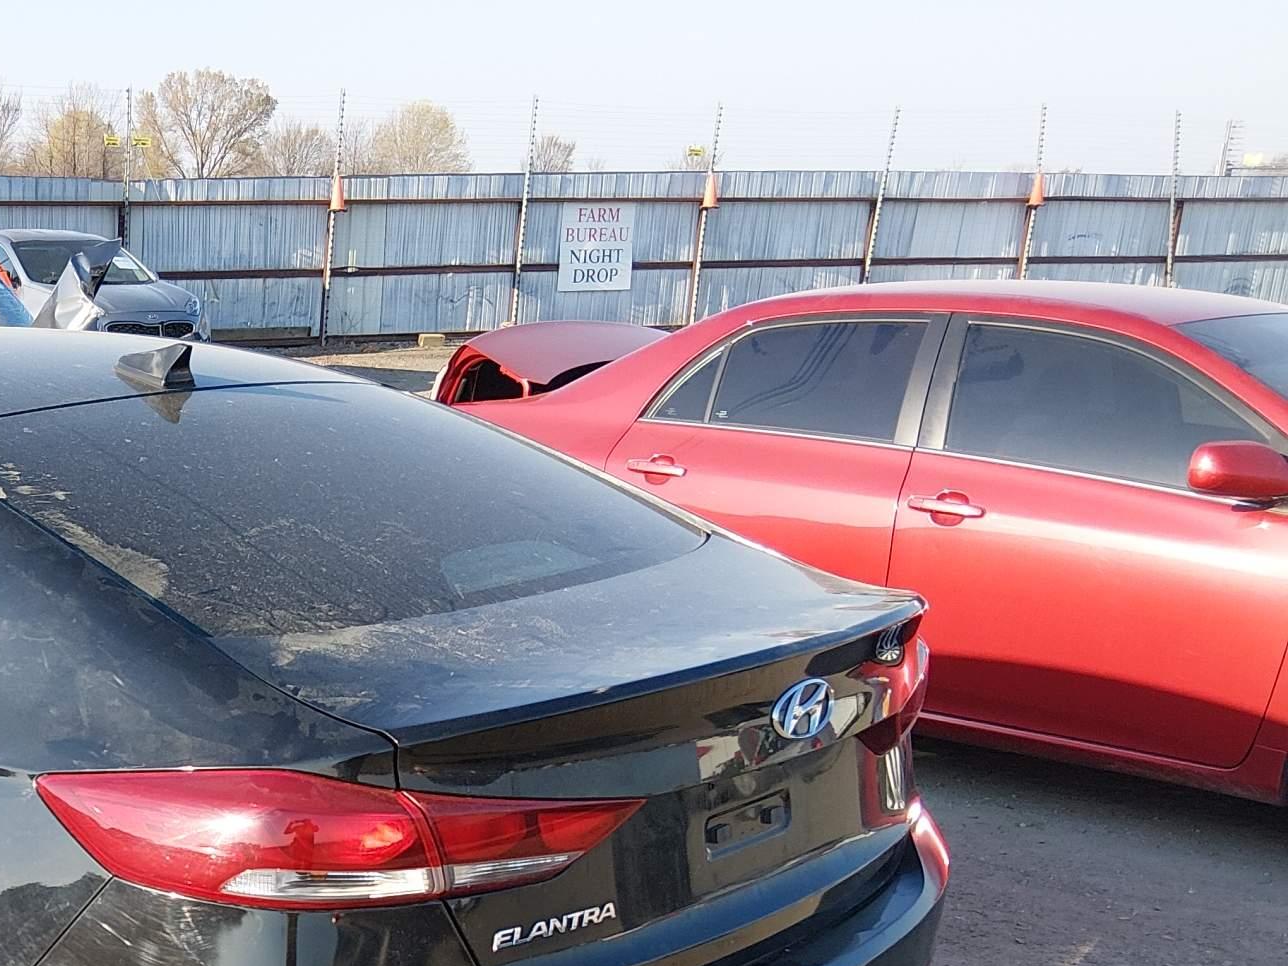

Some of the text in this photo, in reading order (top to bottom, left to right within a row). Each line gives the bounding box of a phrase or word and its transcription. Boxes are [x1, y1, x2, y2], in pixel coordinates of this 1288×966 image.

[578, 207, 621, 223] FARM
[565, 226, 630, 243] BUREAU
[569, 248, 624, 264] NIGHT
[573, 267, 619, 284] DROP
[492, 902, 617, 952] ELANTRA
